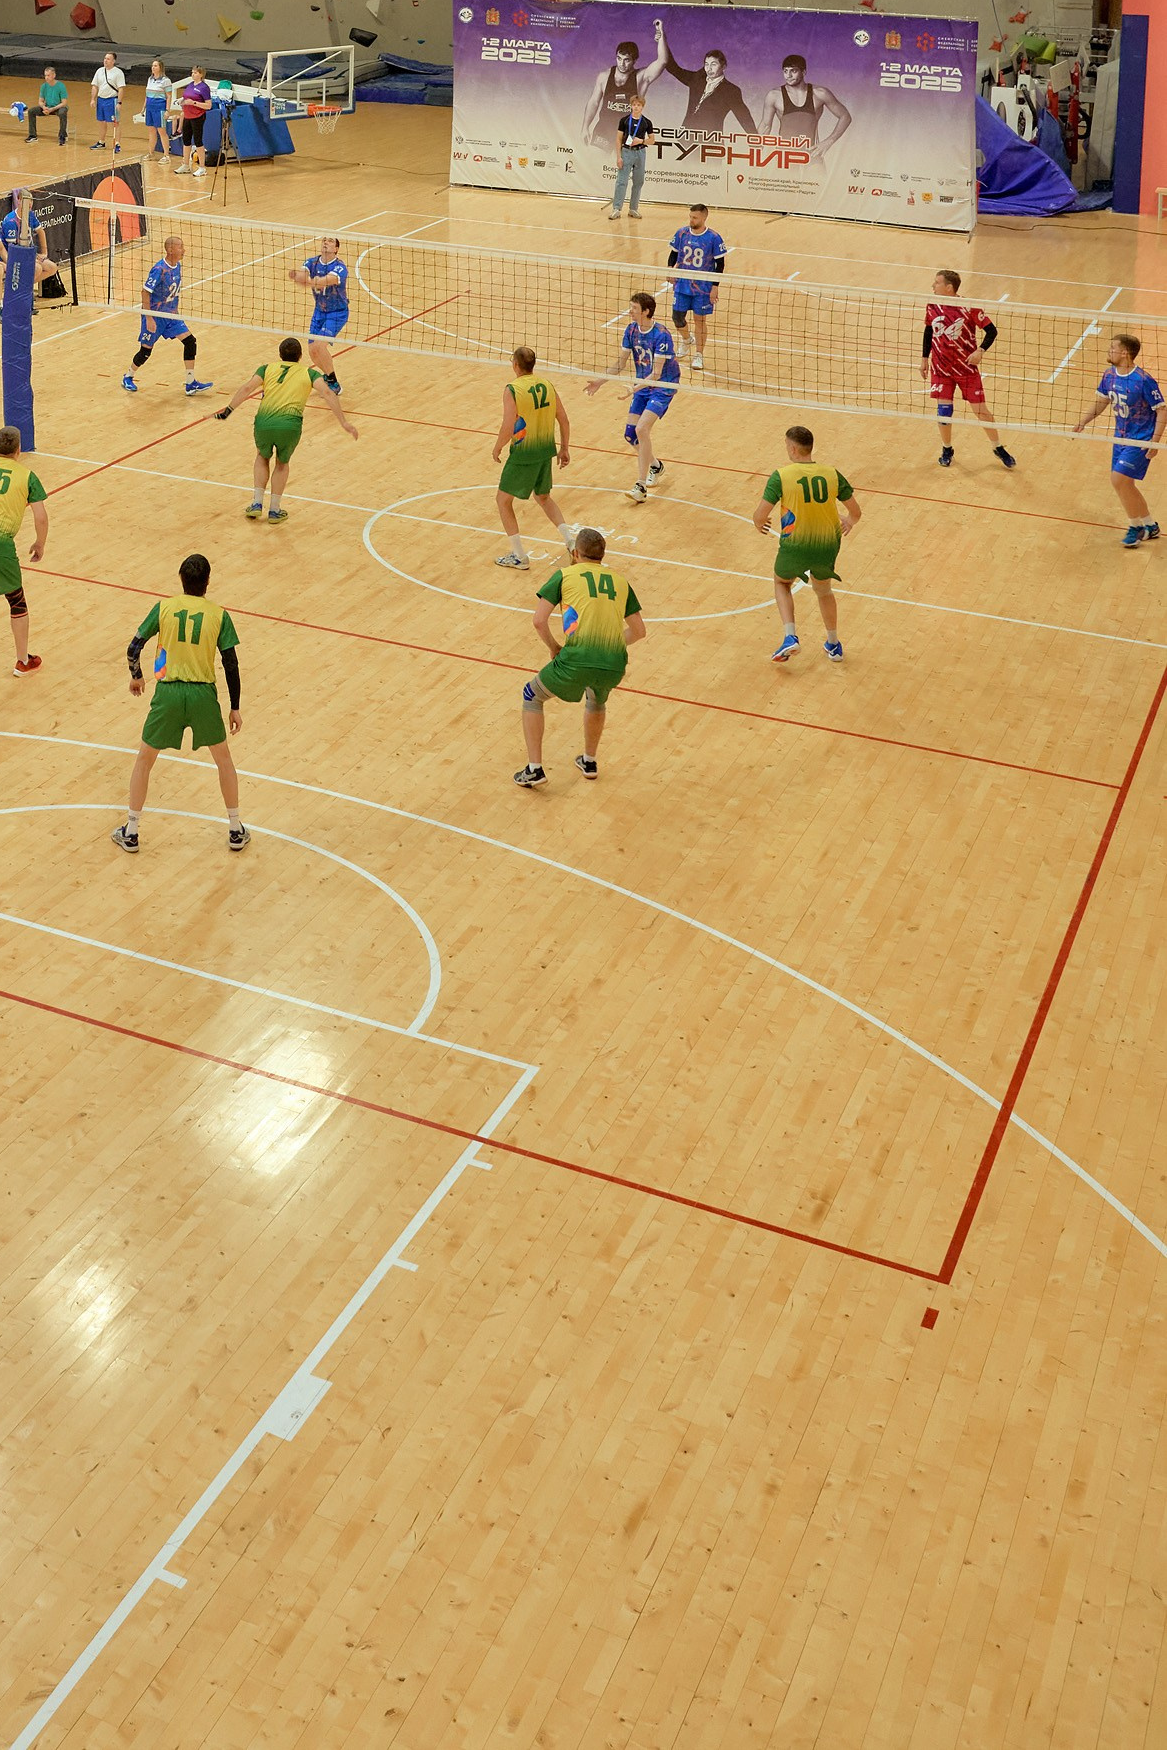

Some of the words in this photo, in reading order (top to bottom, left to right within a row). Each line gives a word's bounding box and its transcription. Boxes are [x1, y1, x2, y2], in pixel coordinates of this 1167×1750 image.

[481, 38, 499, 46] 1-2
[503, 38, 552, 51] МАРТА
[481, 46, 551, 65] 2025
[880, 62, 901, 72] 1-2
[904, 63, 963, 77] МАРТА
[880, 72, 962, 93] 2025
[652, 125, 811, 149] РЕЙТИНГОВЫЙ
[653, 141, 811, 170] ТУРНИР
[645, 176, 683, 184] спортивной
[684, 178, 709, 187] борьбе
[653, 169, 700, 179] соревнования
[700, 173, 720, 181] среди
[41, 213, 73, 229] ЕРАЛЬНОГО
[8, 229, 16, 237] 23
[682, 245, 704, 268] 28
[147, 277, 157, 287] 24
[141, 332, 151, 342] 24
[931, 315, 966, 340] 64
[634, 345, 652, 369] 21
[659, 343, 669, 352] 21
[276, 364, 291, 384] 7
[527, 383, 550, 410] 12
[1108, 390, 1129, 419] 25
[1151, 390, 1161, 400] 25
[796, 475, 829, 504] 10
[579, 571, 617, 601] 14
[174, 609, 204, 645] 11
